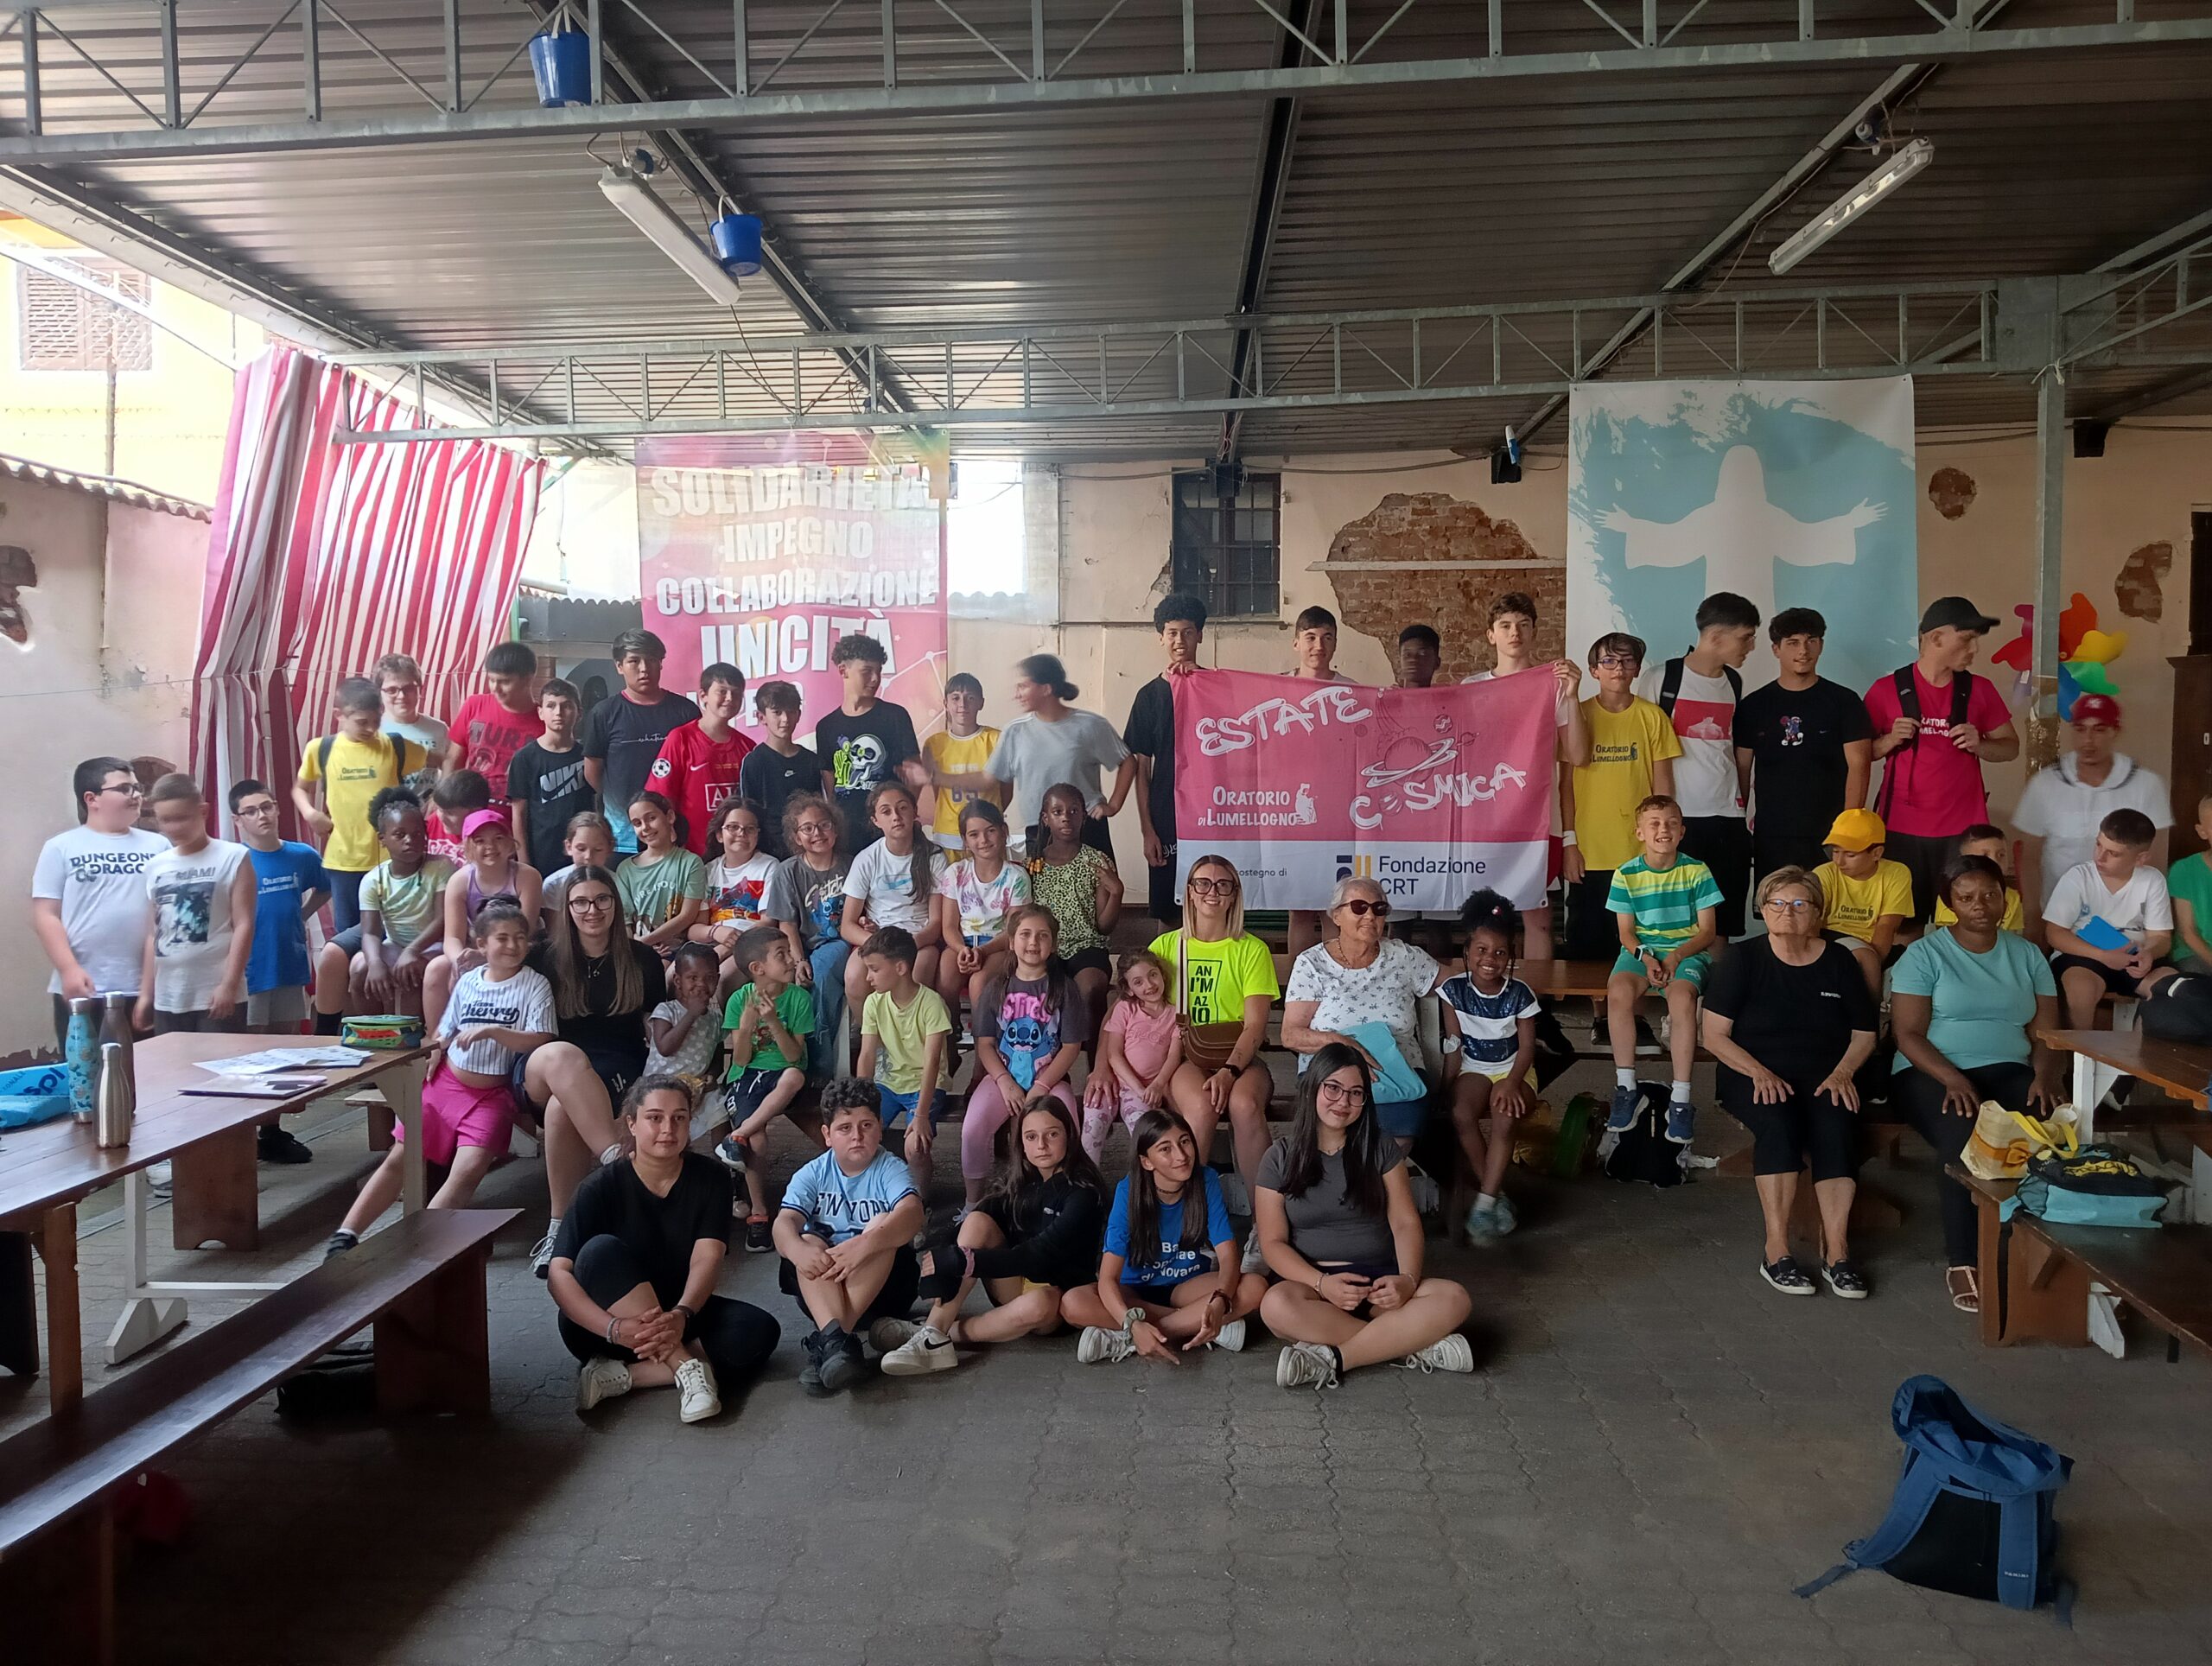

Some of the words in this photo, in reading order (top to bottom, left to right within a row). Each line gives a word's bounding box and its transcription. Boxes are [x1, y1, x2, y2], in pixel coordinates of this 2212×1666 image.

[723, 517, 874, 563] IMPEGNO
[655, 568, 937, 615] COLLABORAZIONE
[701, 609, 896, 681] UNICITÀ
[1195, 687, 1372, 757] ESTATE
[1212, 785, 1291, 806] ORATORIO
[1206, 808, 1297, 826] LUMELLOGNO
[1236, 868, 1276, 879] ostegno
[1278, 868, 1287, 876] di
[1379, 855, 1486, 874] Fondazione
[1379, 878, 1419, 895] CRT
[1195, 965, 1212, 976] AN
[1193, 995, 1209, 1006] AZ
